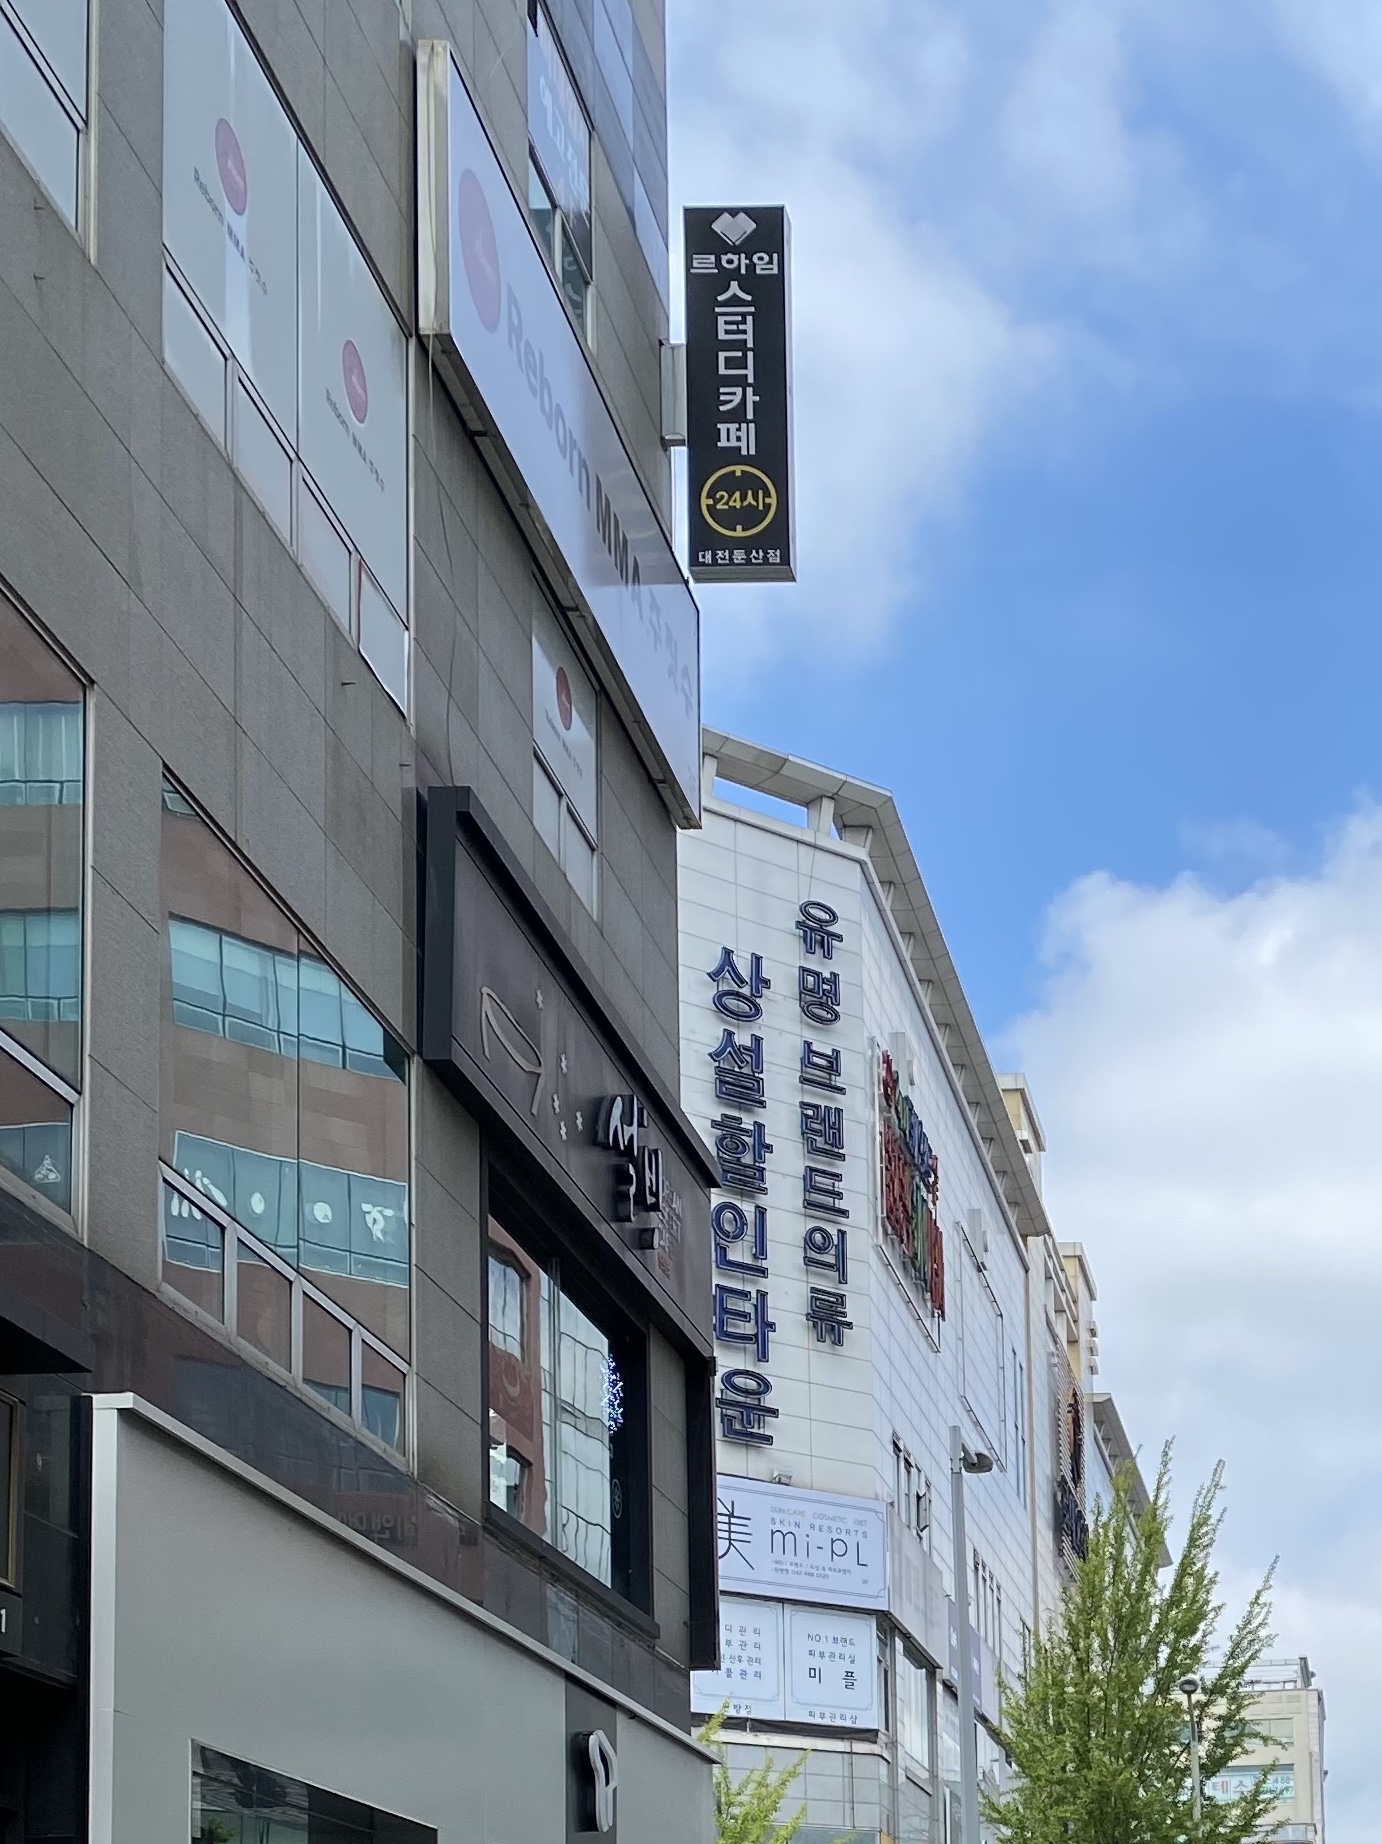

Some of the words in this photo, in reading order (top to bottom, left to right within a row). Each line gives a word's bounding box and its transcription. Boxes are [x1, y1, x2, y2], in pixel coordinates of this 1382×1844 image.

[689, 252, 779, 275] 르하임
[714, 280, 760, 455] 스터디카페
[506, 281, 592, 512] Reborn
[594, 473, 644, 622] MMA
[715, 489, 764, 511] 24시
[698, 548, 781, 565] 대전둔산점
[770, 1517, 801, 1529] SKIN
[809, 1523, 868, 1539] RESORTS
